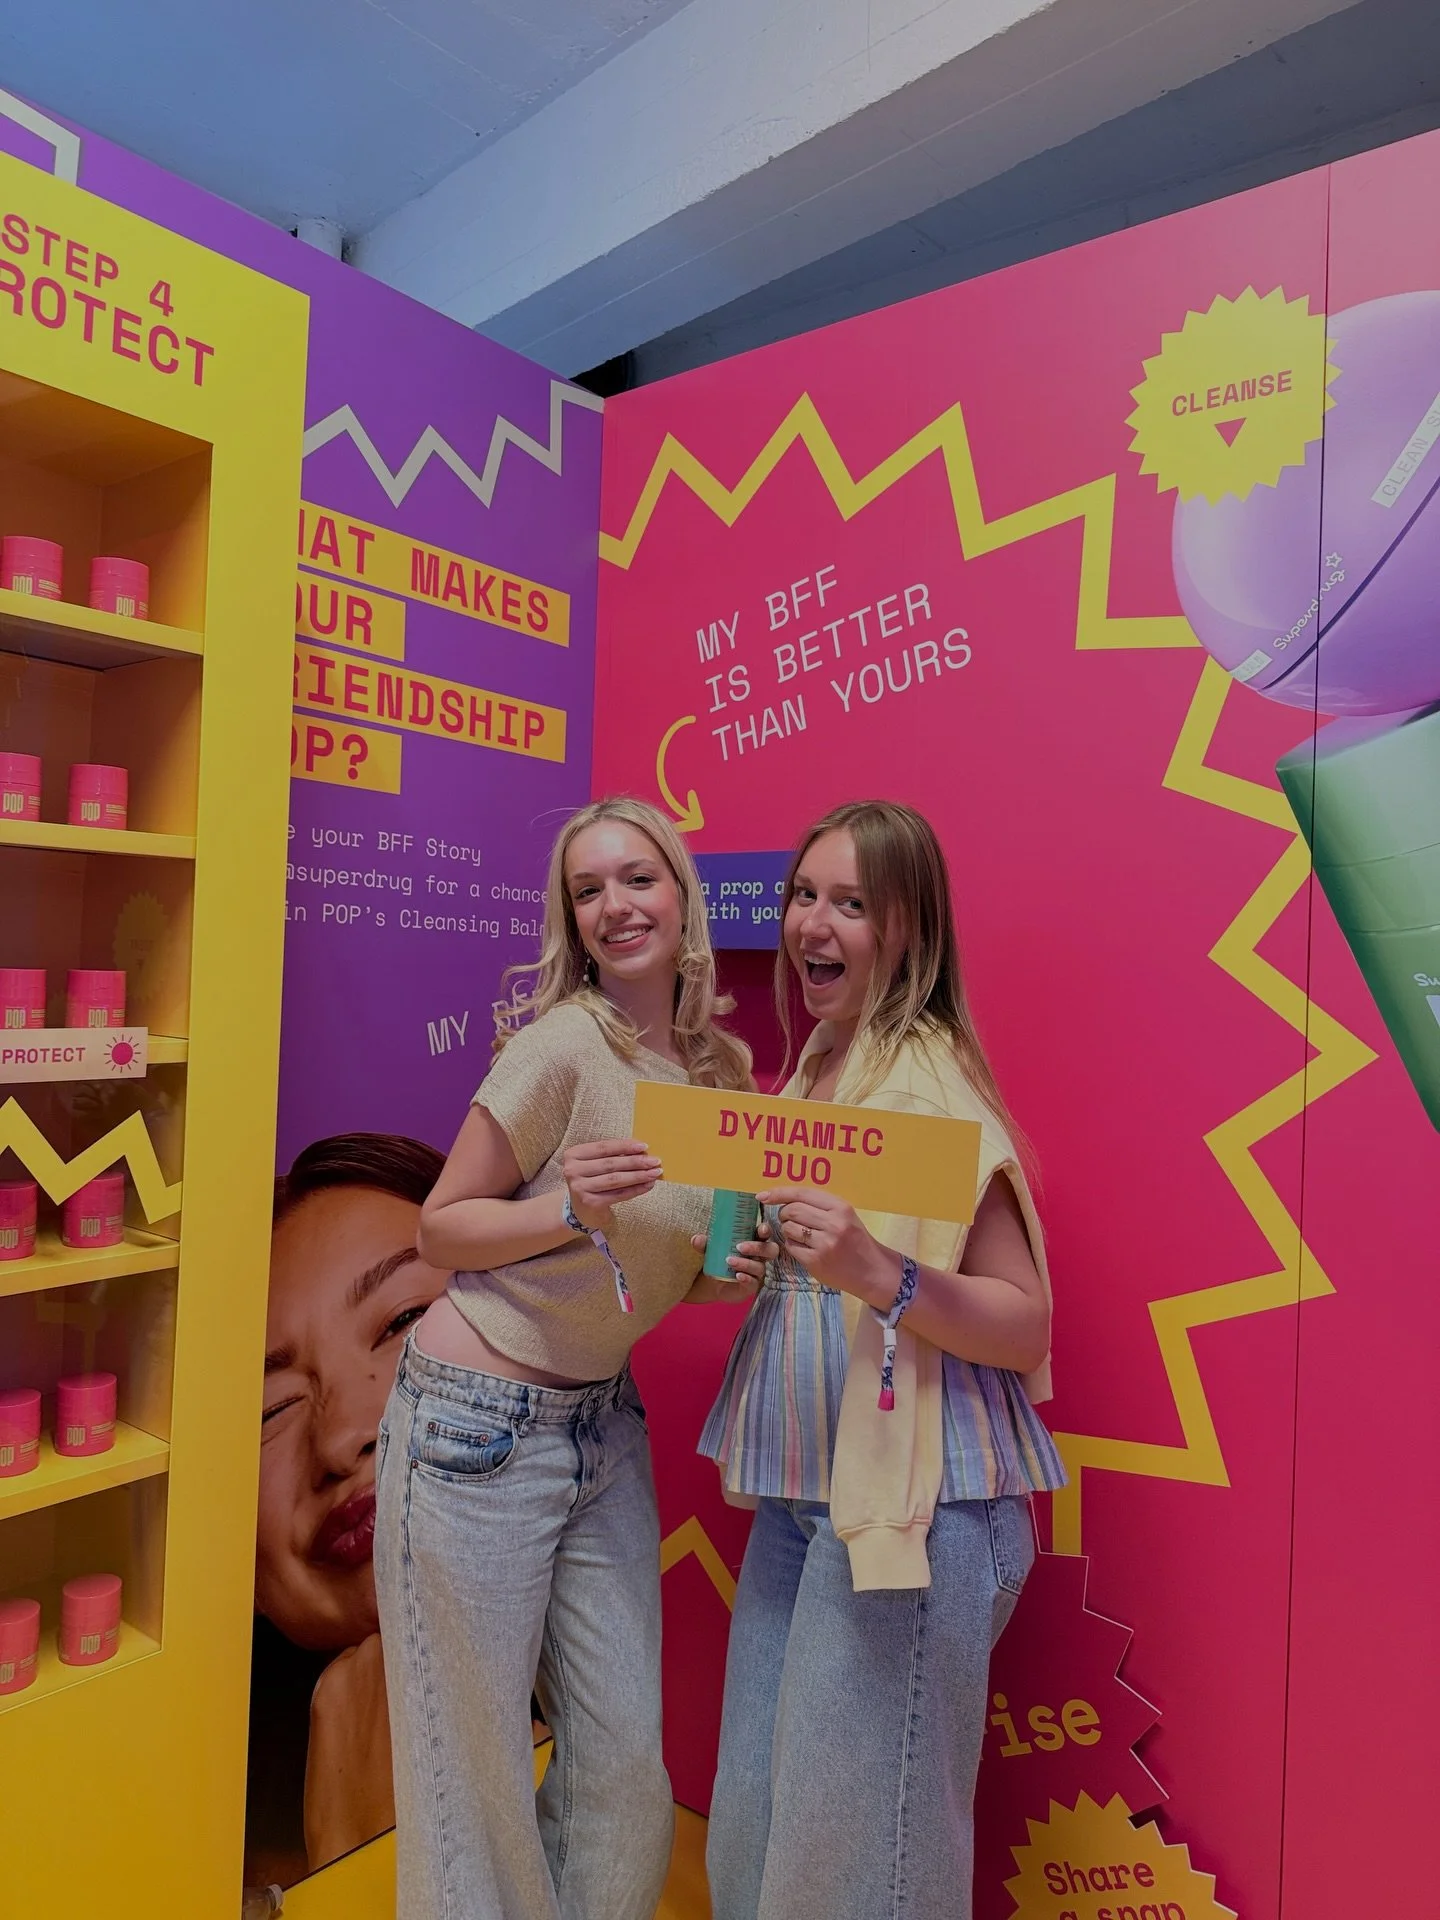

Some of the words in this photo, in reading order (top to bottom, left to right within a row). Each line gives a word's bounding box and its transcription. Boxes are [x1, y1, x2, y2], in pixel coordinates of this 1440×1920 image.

[1, 214, 119, 288] STEP
[149, 279, 174, 317] 4
[1172, 369, 1292, 416] CLEANSE
[1382, 438, 1428, 496] CLEAN
[298, 508, 375, 575] AT
[411, 547, 549, 632] MAKES
[296, 582, 373, 646] UR
[696, 610, 739, 664] MY
[765, 564, 837, 631] BFF
[705, 664, 750, 713] IS
[773, 583, 932, 684] BETTER
[293, 653, 545, 749] IENDSHIP
[712, 694, 807, 761] THAN
[830, 627, 972, 713] YOURS
[291, 725, 369, 780] P?
[3, 792, 24, 813] POP
[81, 801, 101, 821] POP
[311, 827, 364, 848] your
[378, 831, 414, 853] BFF
[426, 838, 481, 866] Story
[426, 875, 458, 895] for
[470, 886, 480, 897] a
[720, 881, 763, 900] prop
[400, 909, 500, 938] Cleansing
[706, 901, 740, 919] ith
[2, 1047, 86, 1064] PROTECT
[427, 1010, 469, 1056] MY
[718, 1109, 883, 1156] DYNAMIC
[762, 1150, 831, 1185] DUO
[984, 1692, 1102, 1758] ise
[1043, 1861, 1155, 1896] Share
